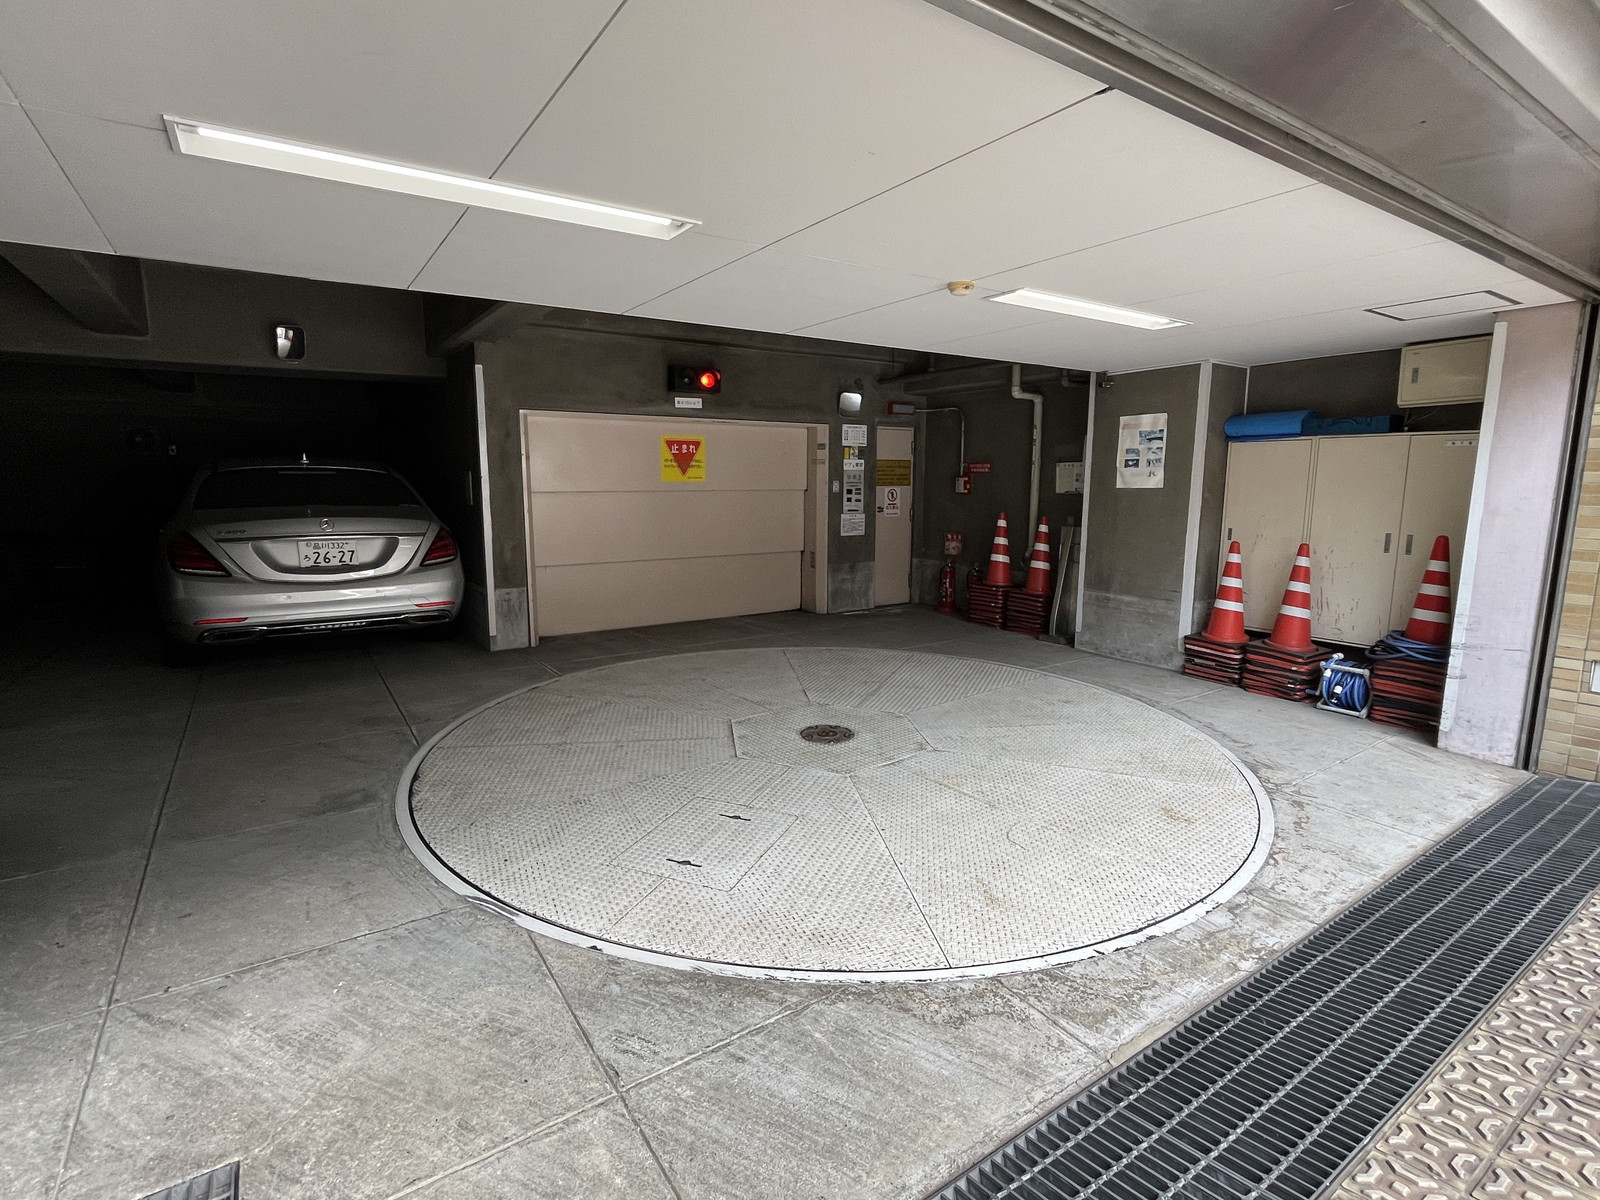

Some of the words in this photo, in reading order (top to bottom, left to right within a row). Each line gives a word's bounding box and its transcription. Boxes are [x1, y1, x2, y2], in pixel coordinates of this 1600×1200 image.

[671, 443, 697, 454] 止まれ
[312, 550, 355, 565] 26-27
